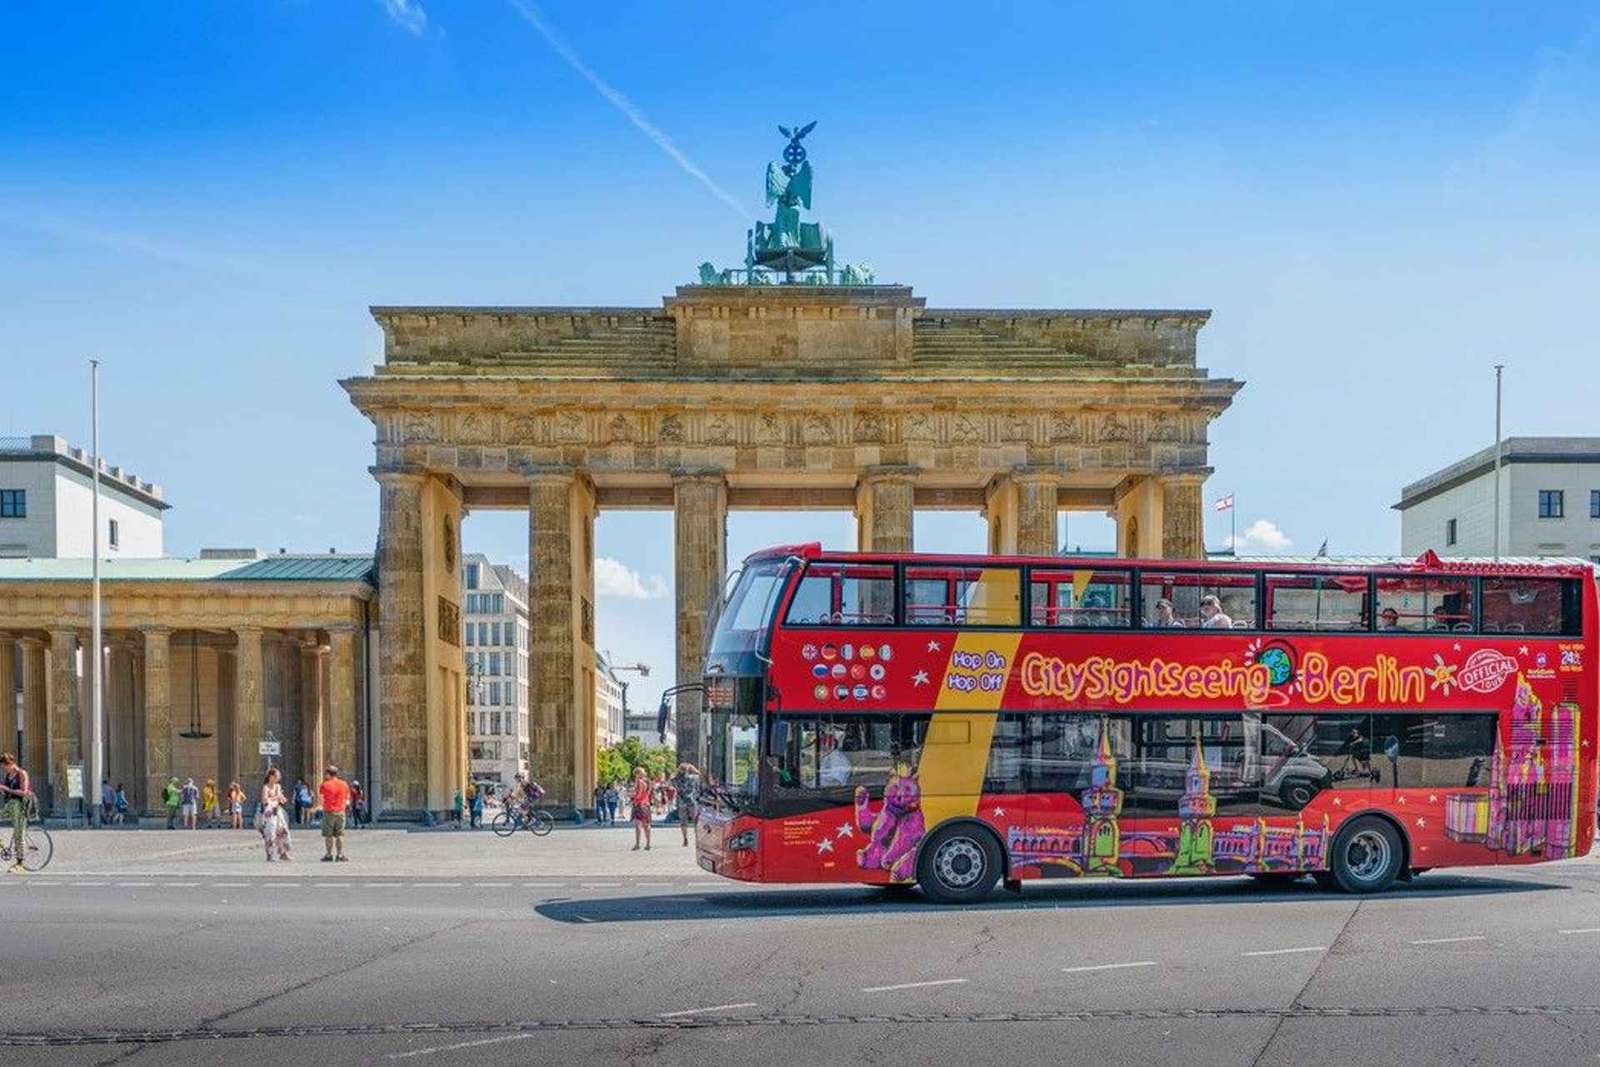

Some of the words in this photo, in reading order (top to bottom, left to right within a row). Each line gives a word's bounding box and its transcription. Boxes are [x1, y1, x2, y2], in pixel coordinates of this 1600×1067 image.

[953, 650, 983, 671] Hop
[985, 650, 1006, 669] On
[1464, 659, 1515, 685] OFFICIAL
[948, 673, 977, 693] Hop
[980, 672, 1003, 692] Off
[1021, 652, 1270, 704] CitySightseeing
[1302, 652, 1425, 704] Berlin
